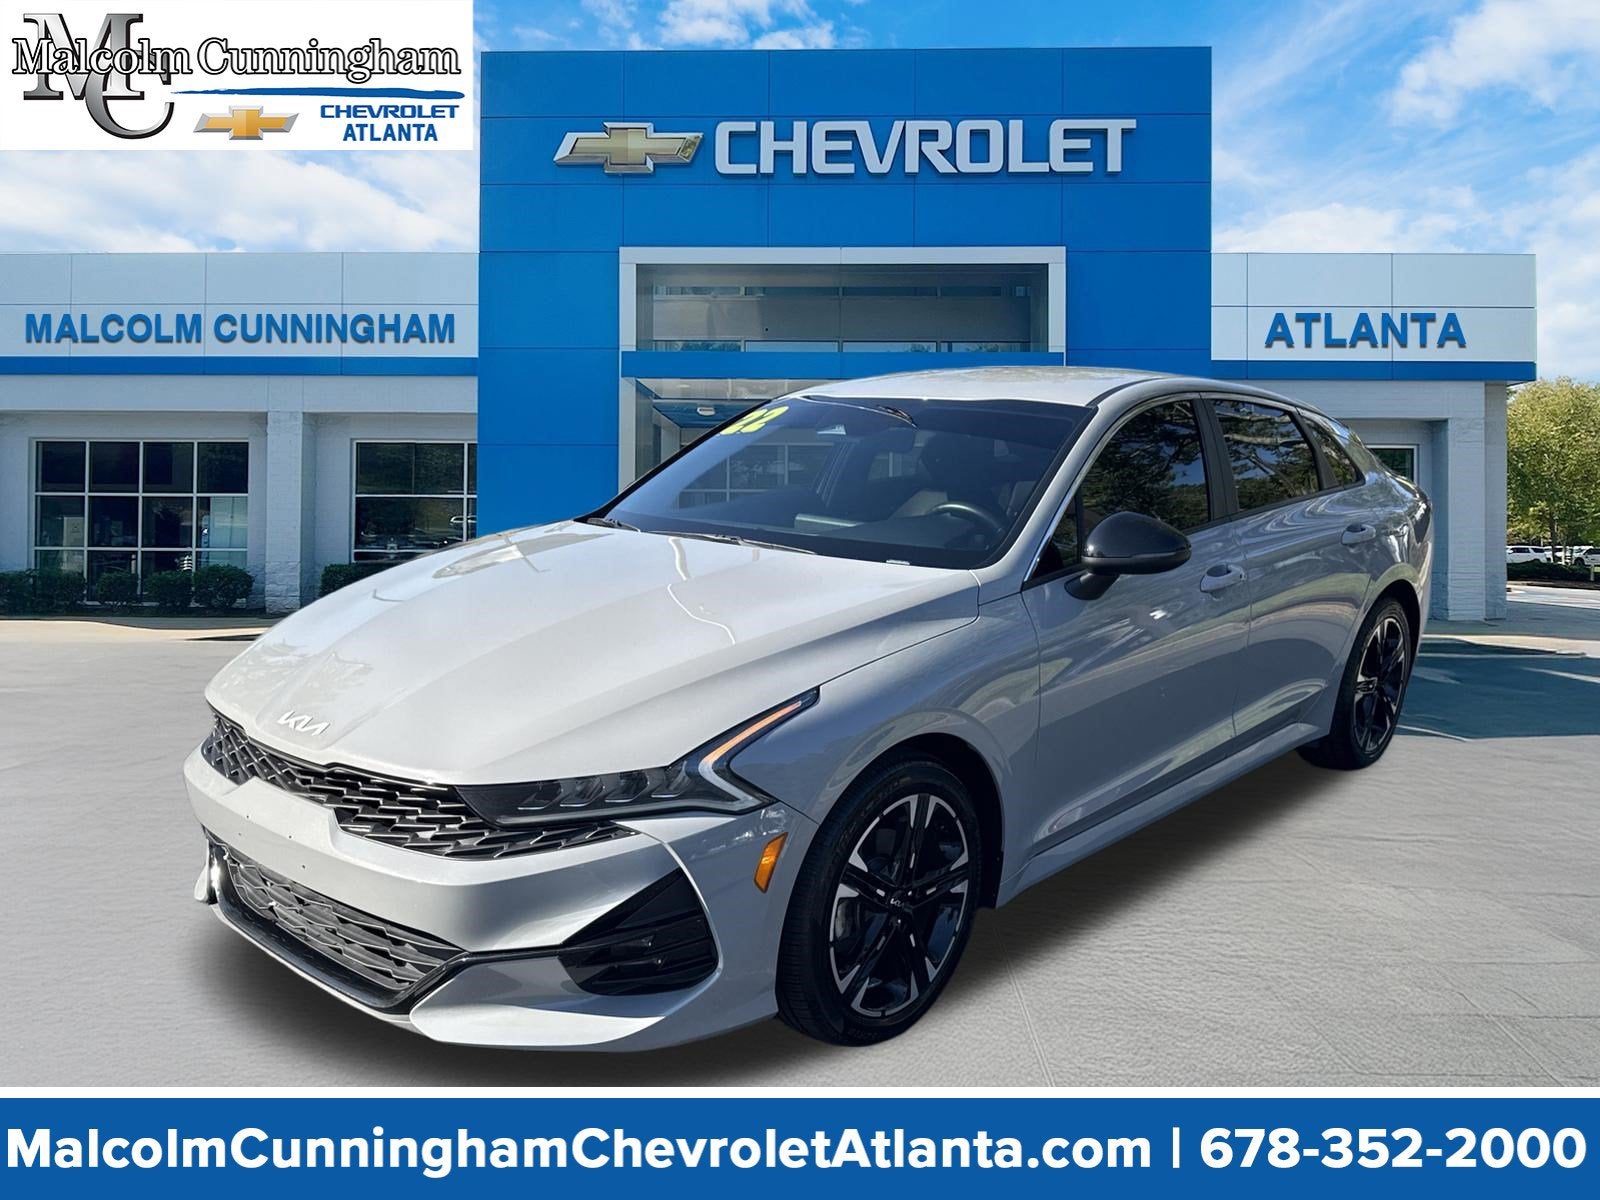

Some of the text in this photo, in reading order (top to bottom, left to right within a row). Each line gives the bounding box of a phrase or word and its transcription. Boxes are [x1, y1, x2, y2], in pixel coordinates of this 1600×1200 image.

[714, 119, 1137, 175] CHEVROLET
[25, 313, 455, 343] MALCOLM CUNNINGHAM
[1264, 312, 1467, 348] ATLANTA
[277, 710, 330, 736] KIA
